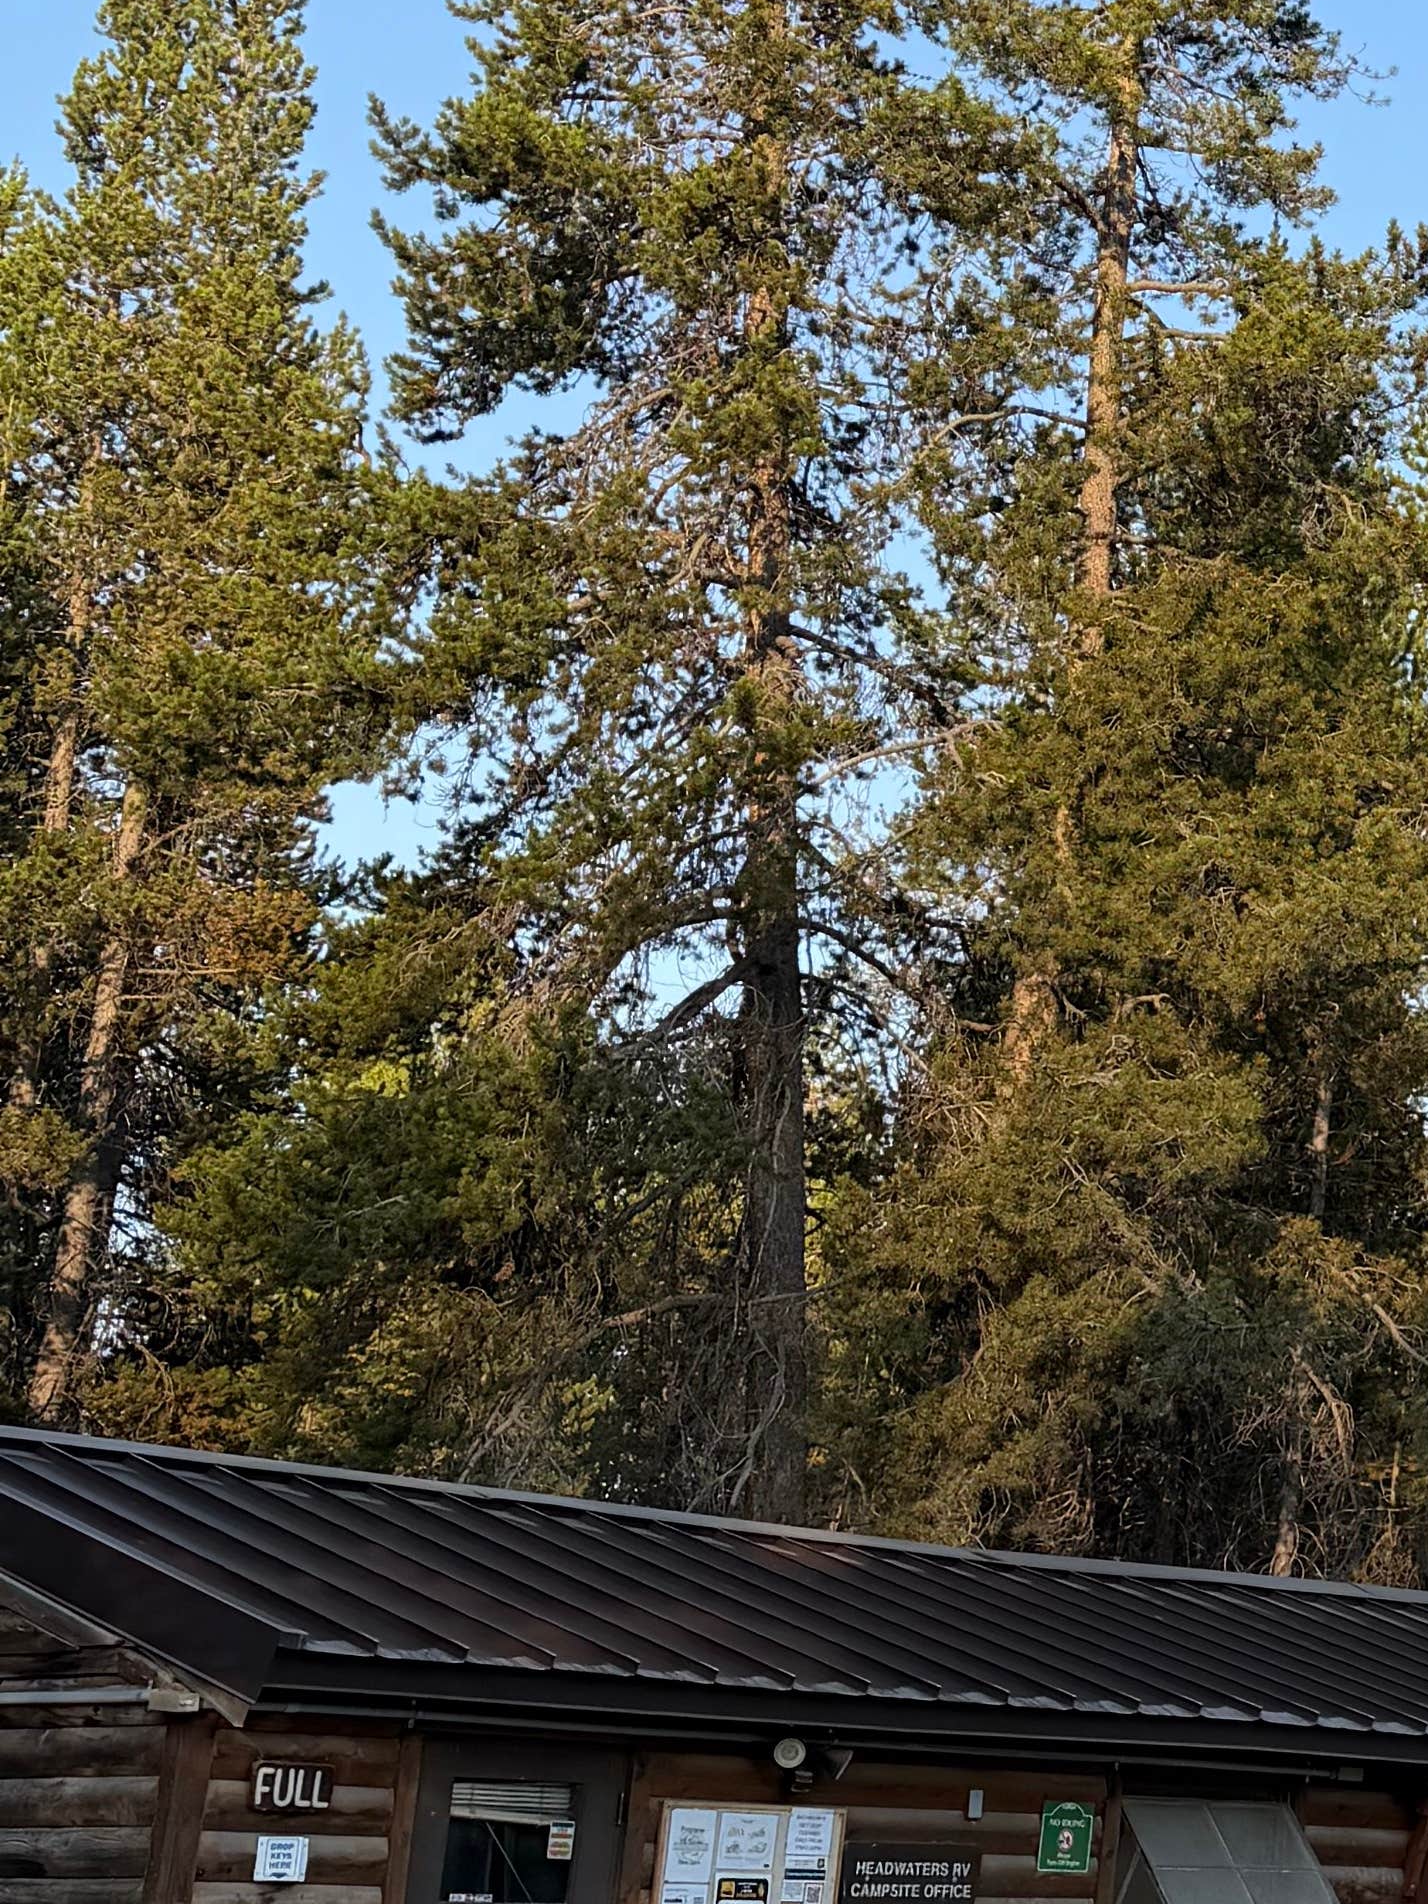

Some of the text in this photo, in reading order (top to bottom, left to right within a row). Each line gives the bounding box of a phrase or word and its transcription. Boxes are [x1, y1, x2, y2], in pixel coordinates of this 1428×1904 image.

[254, 1766, 329, 1809] FULL
[855, 1861, 971, 1878] HEADWATERS RV
[850, 1882, 972, 1899] CAMPSITE OFFICE
